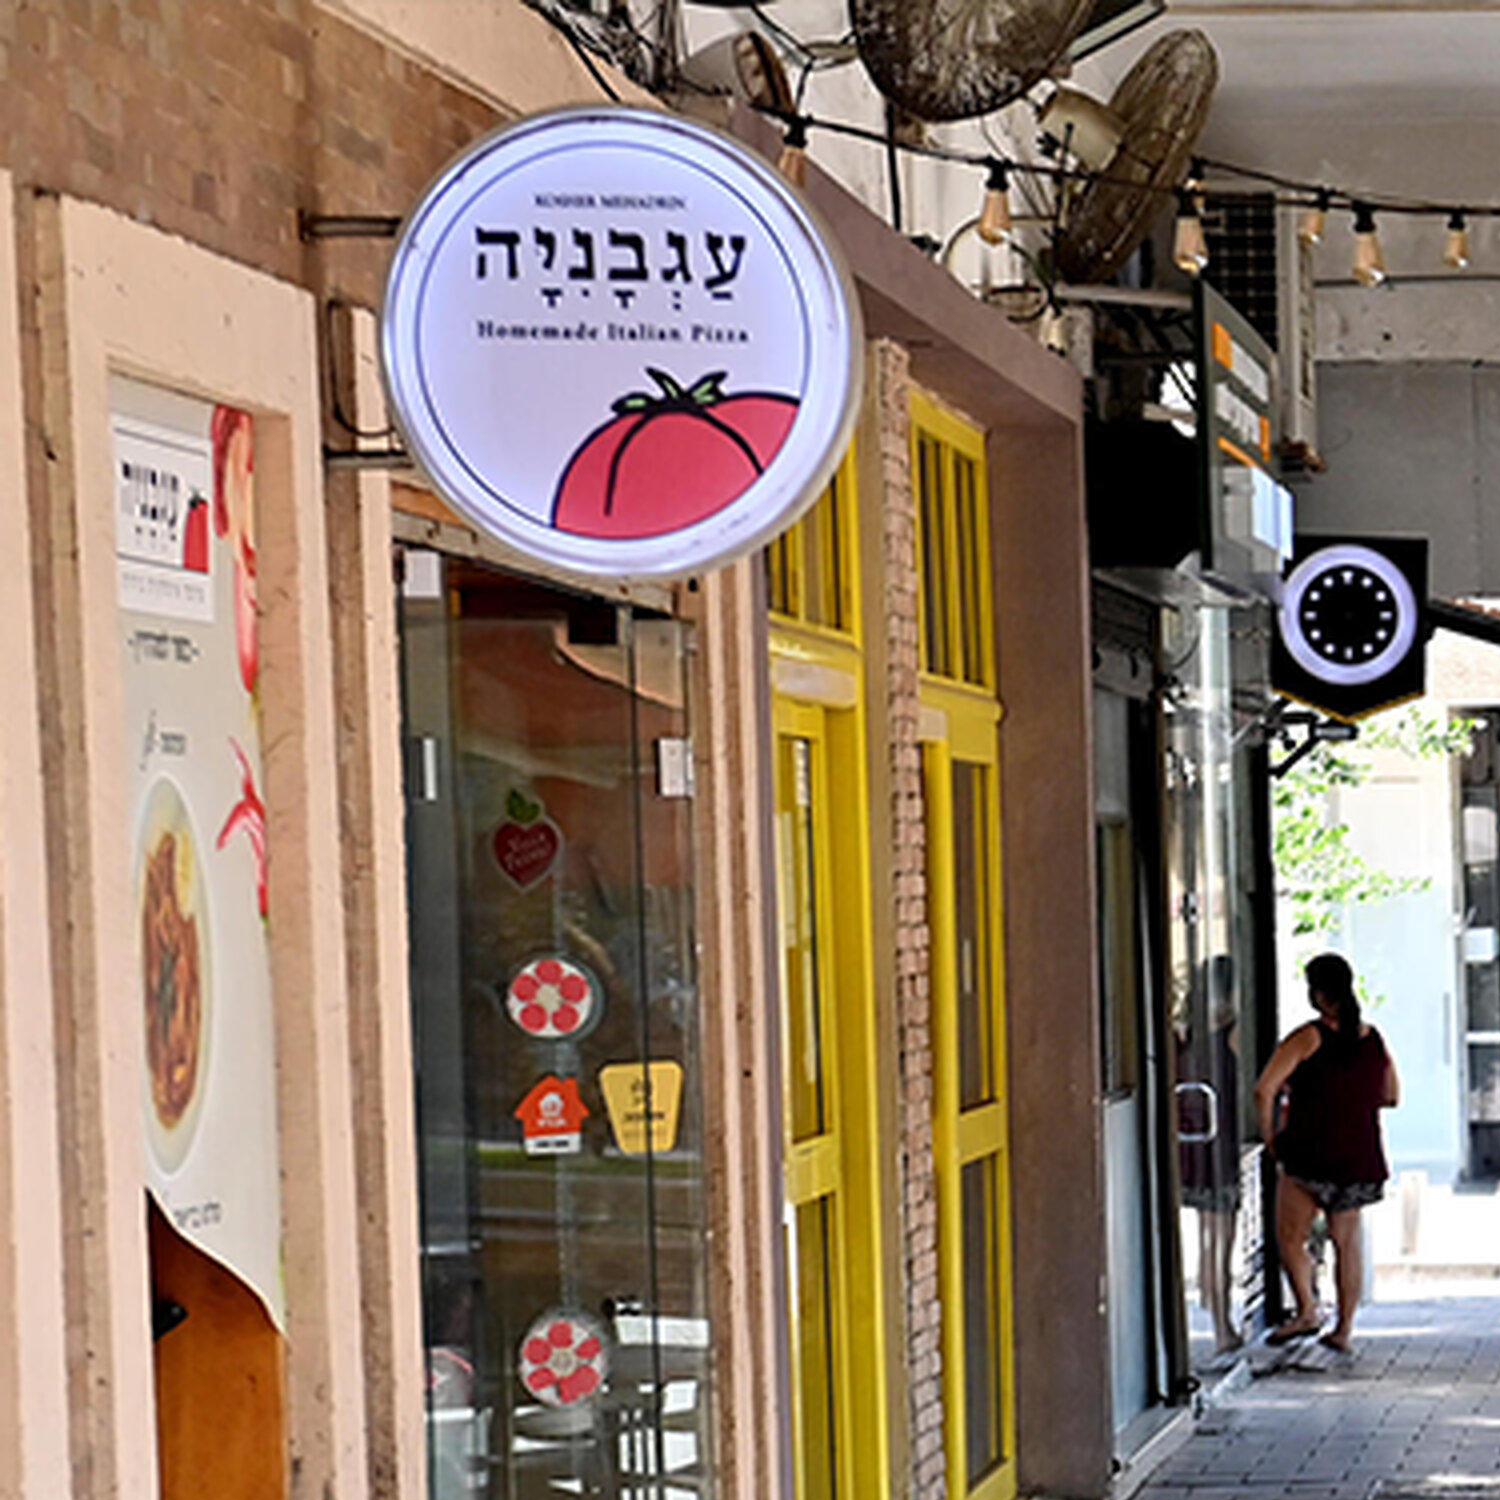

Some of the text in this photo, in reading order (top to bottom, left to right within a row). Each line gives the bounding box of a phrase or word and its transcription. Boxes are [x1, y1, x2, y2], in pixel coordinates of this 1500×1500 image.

[477, 321, 749, 343] Homemade Italian Pizza
